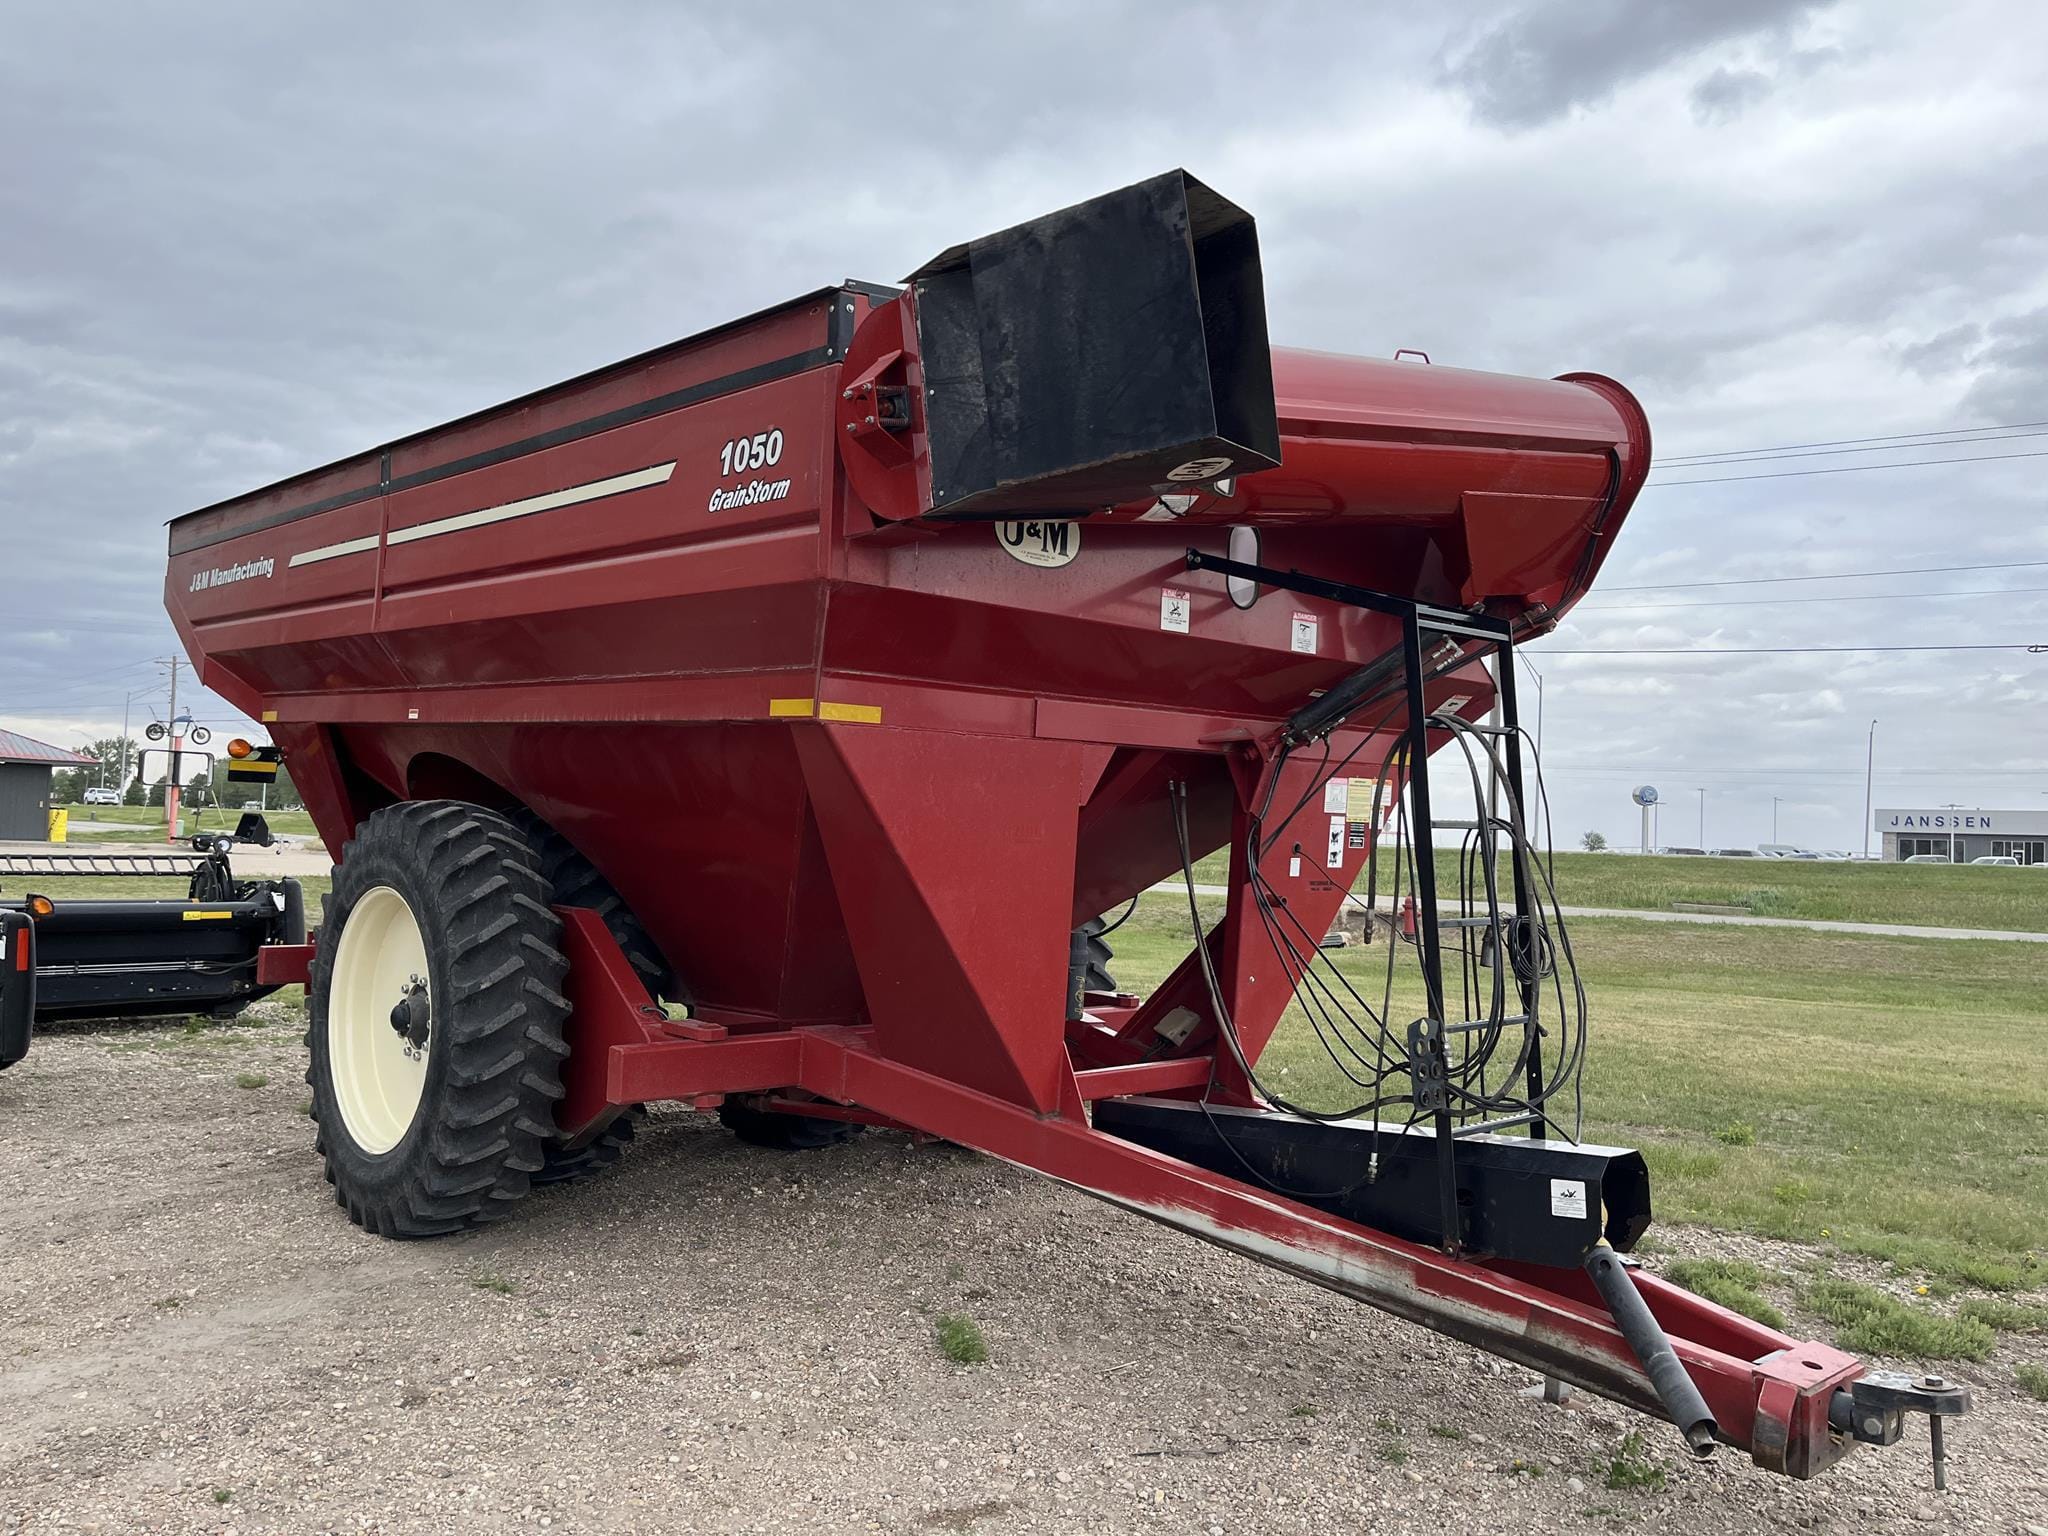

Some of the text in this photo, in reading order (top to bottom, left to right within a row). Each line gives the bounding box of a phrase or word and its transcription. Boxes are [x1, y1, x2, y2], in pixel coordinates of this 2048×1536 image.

[720, 429, 783, 476] 1050
[708, 479, 791, 512] GrainStorm
[189, 556, 275, 592] J&M Manufacturing
[1891, 815, 1991, 828] JANSSEN
